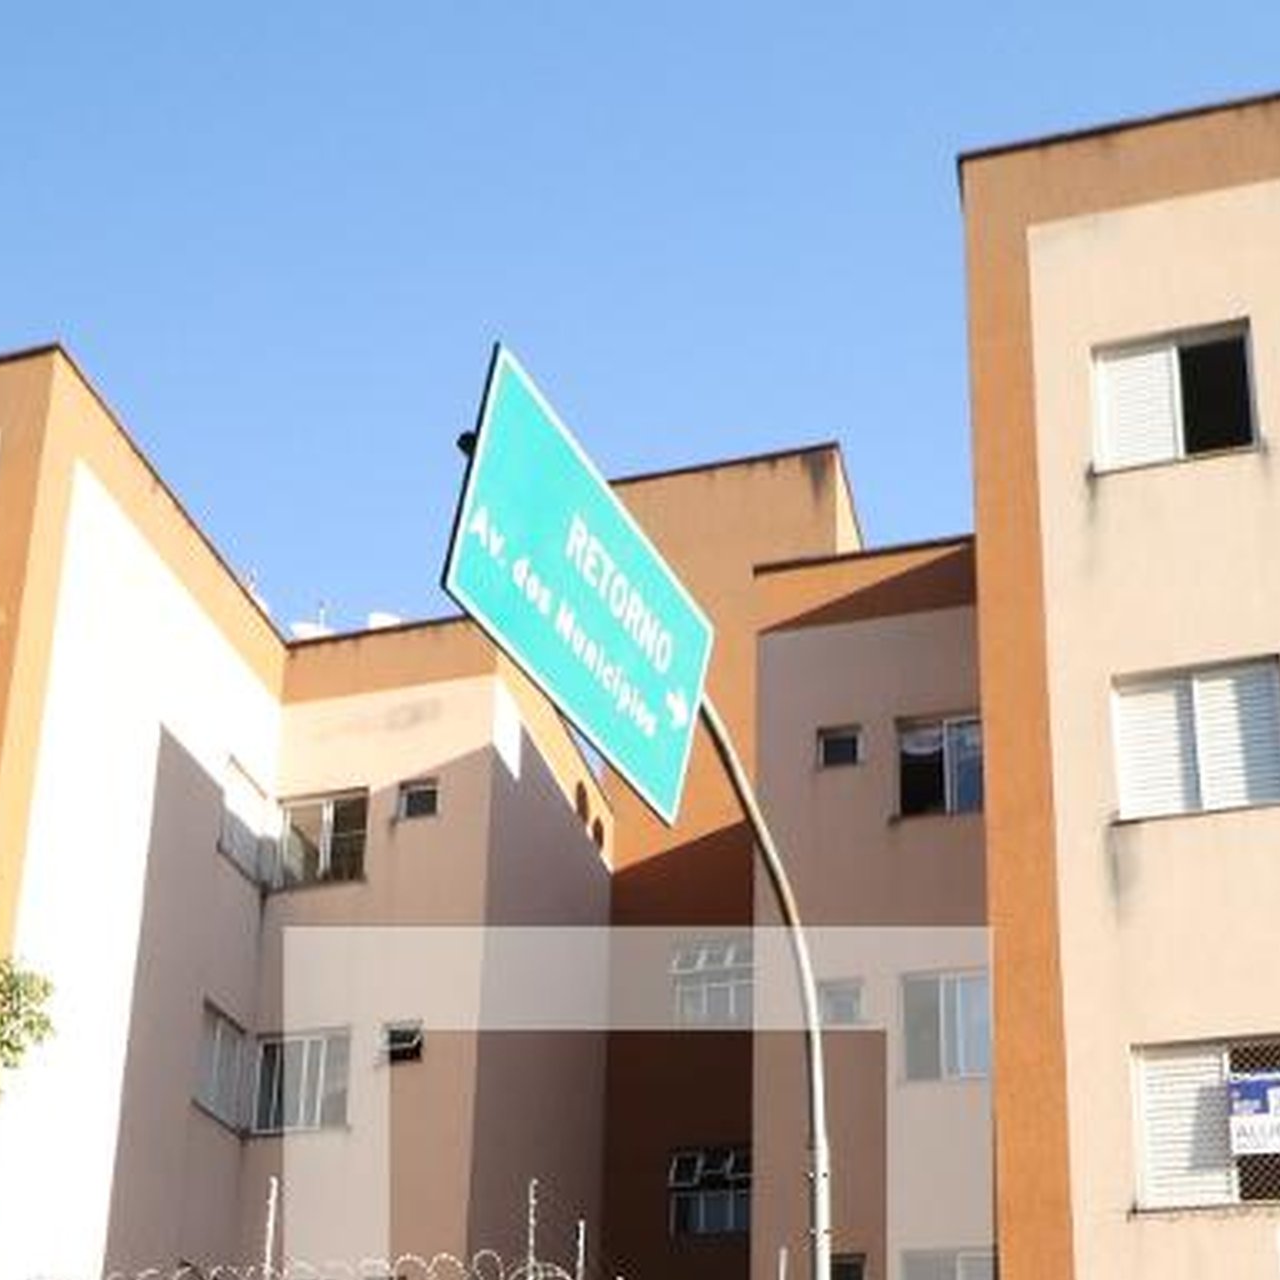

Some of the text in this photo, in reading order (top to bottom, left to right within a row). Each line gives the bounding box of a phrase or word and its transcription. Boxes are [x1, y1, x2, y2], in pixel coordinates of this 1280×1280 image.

[469, 505, 506, 568] Av.
[512, 558, 552, 615] dos
[566, 514, 672, 674] RETORNO
